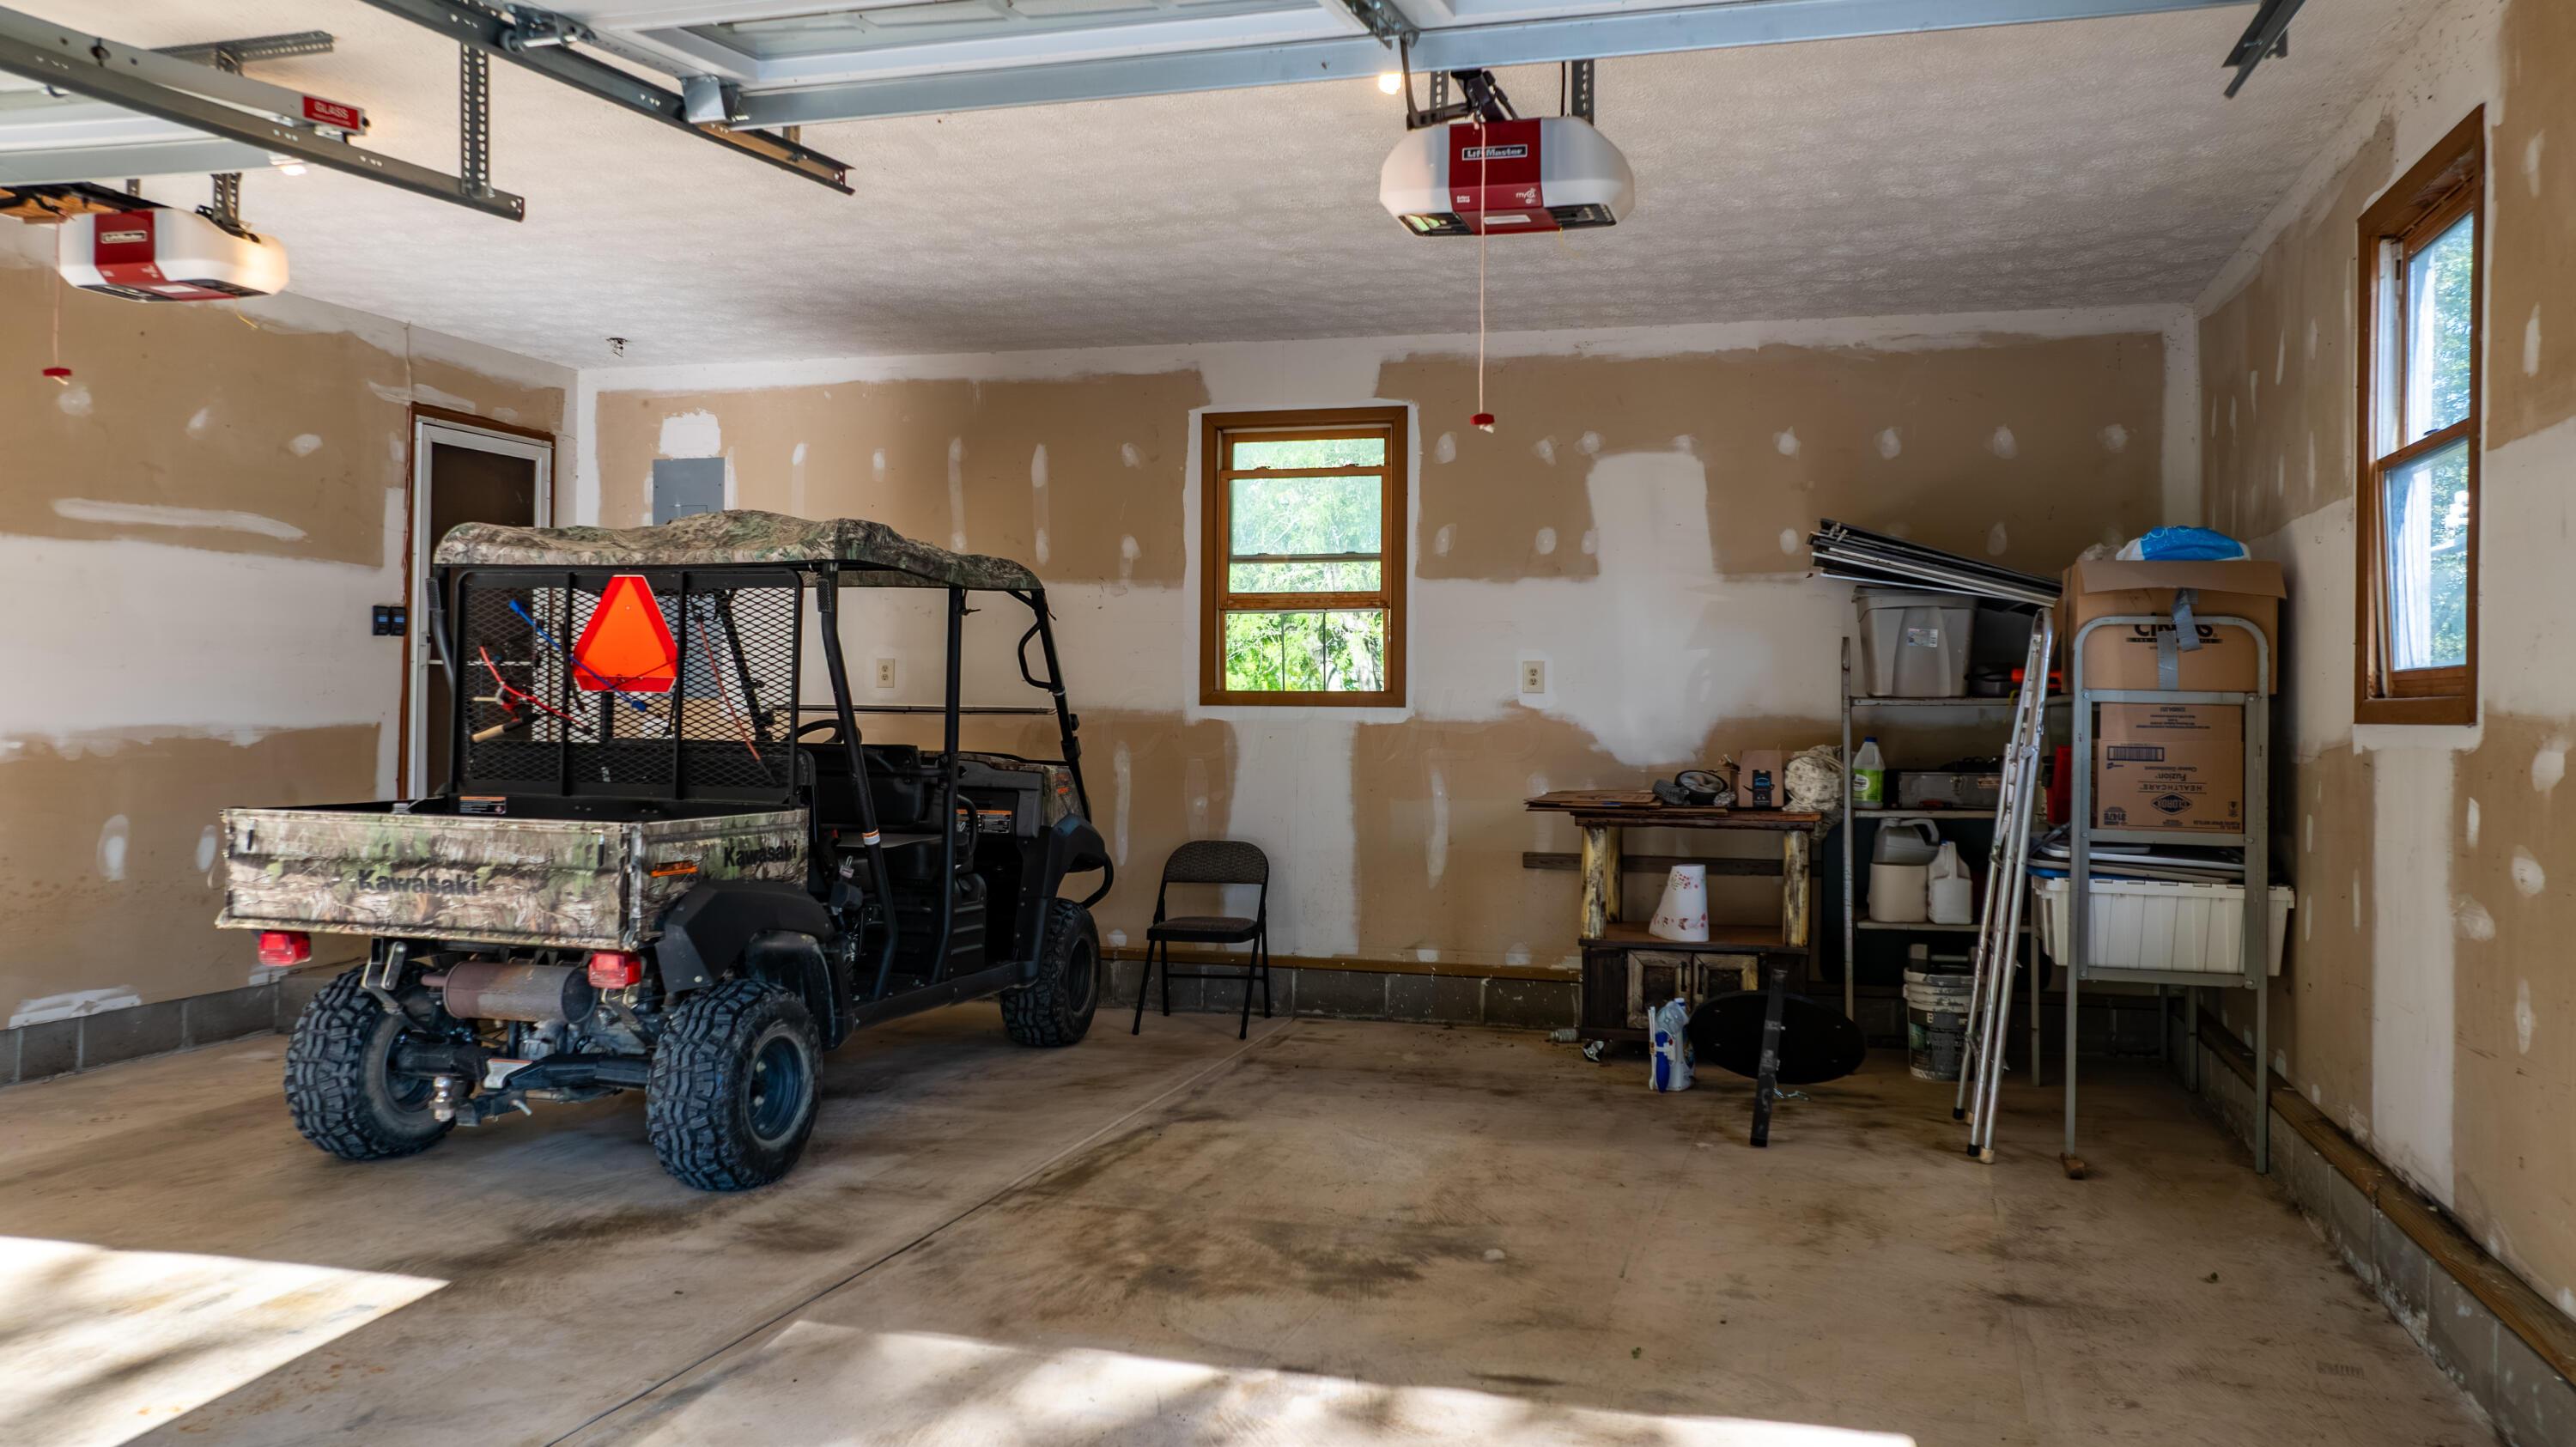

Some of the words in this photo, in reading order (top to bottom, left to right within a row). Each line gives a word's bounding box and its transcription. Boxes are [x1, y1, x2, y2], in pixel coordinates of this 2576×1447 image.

[314, 100, 349, 119] GLASS
[1467, 148, 1522, 159] LifMaster
[2158, 773, 2186, 781] Fuzion
[724, 839, 797, 867] Kawasaki
[358, 869, 479, 896] Kawasaki
